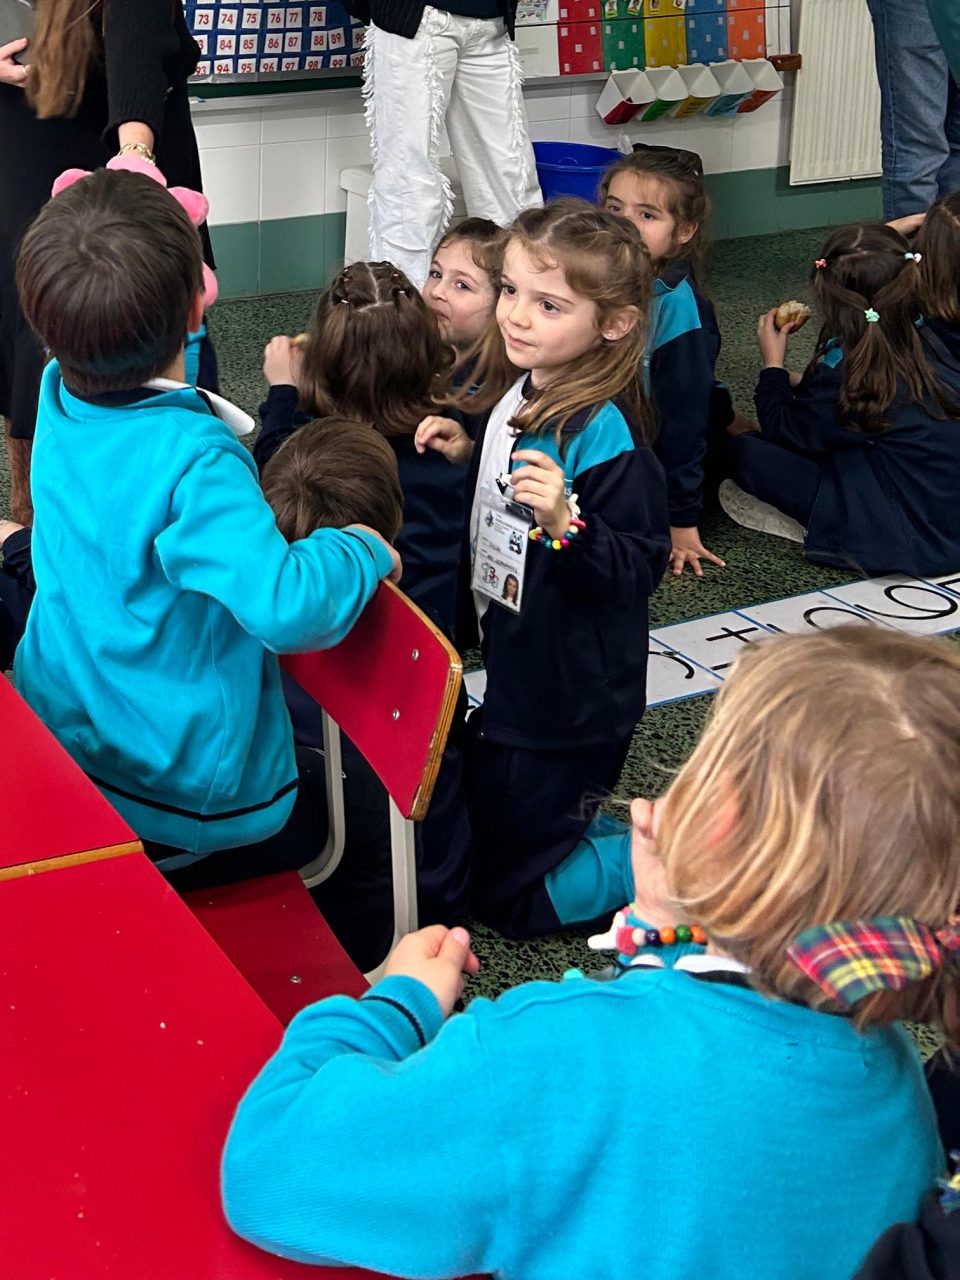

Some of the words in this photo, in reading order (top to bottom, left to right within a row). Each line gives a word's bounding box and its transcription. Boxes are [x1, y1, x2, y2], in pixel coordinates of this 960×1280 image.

[199, 13, 210, 25] 73
[222, 12, 235, 23] 74
[246, 12, 257, 25] 75
[271, 12, 282, 25] 76
[289, 10, 299, 22] 77
[312, 10, 324, 22] 78
